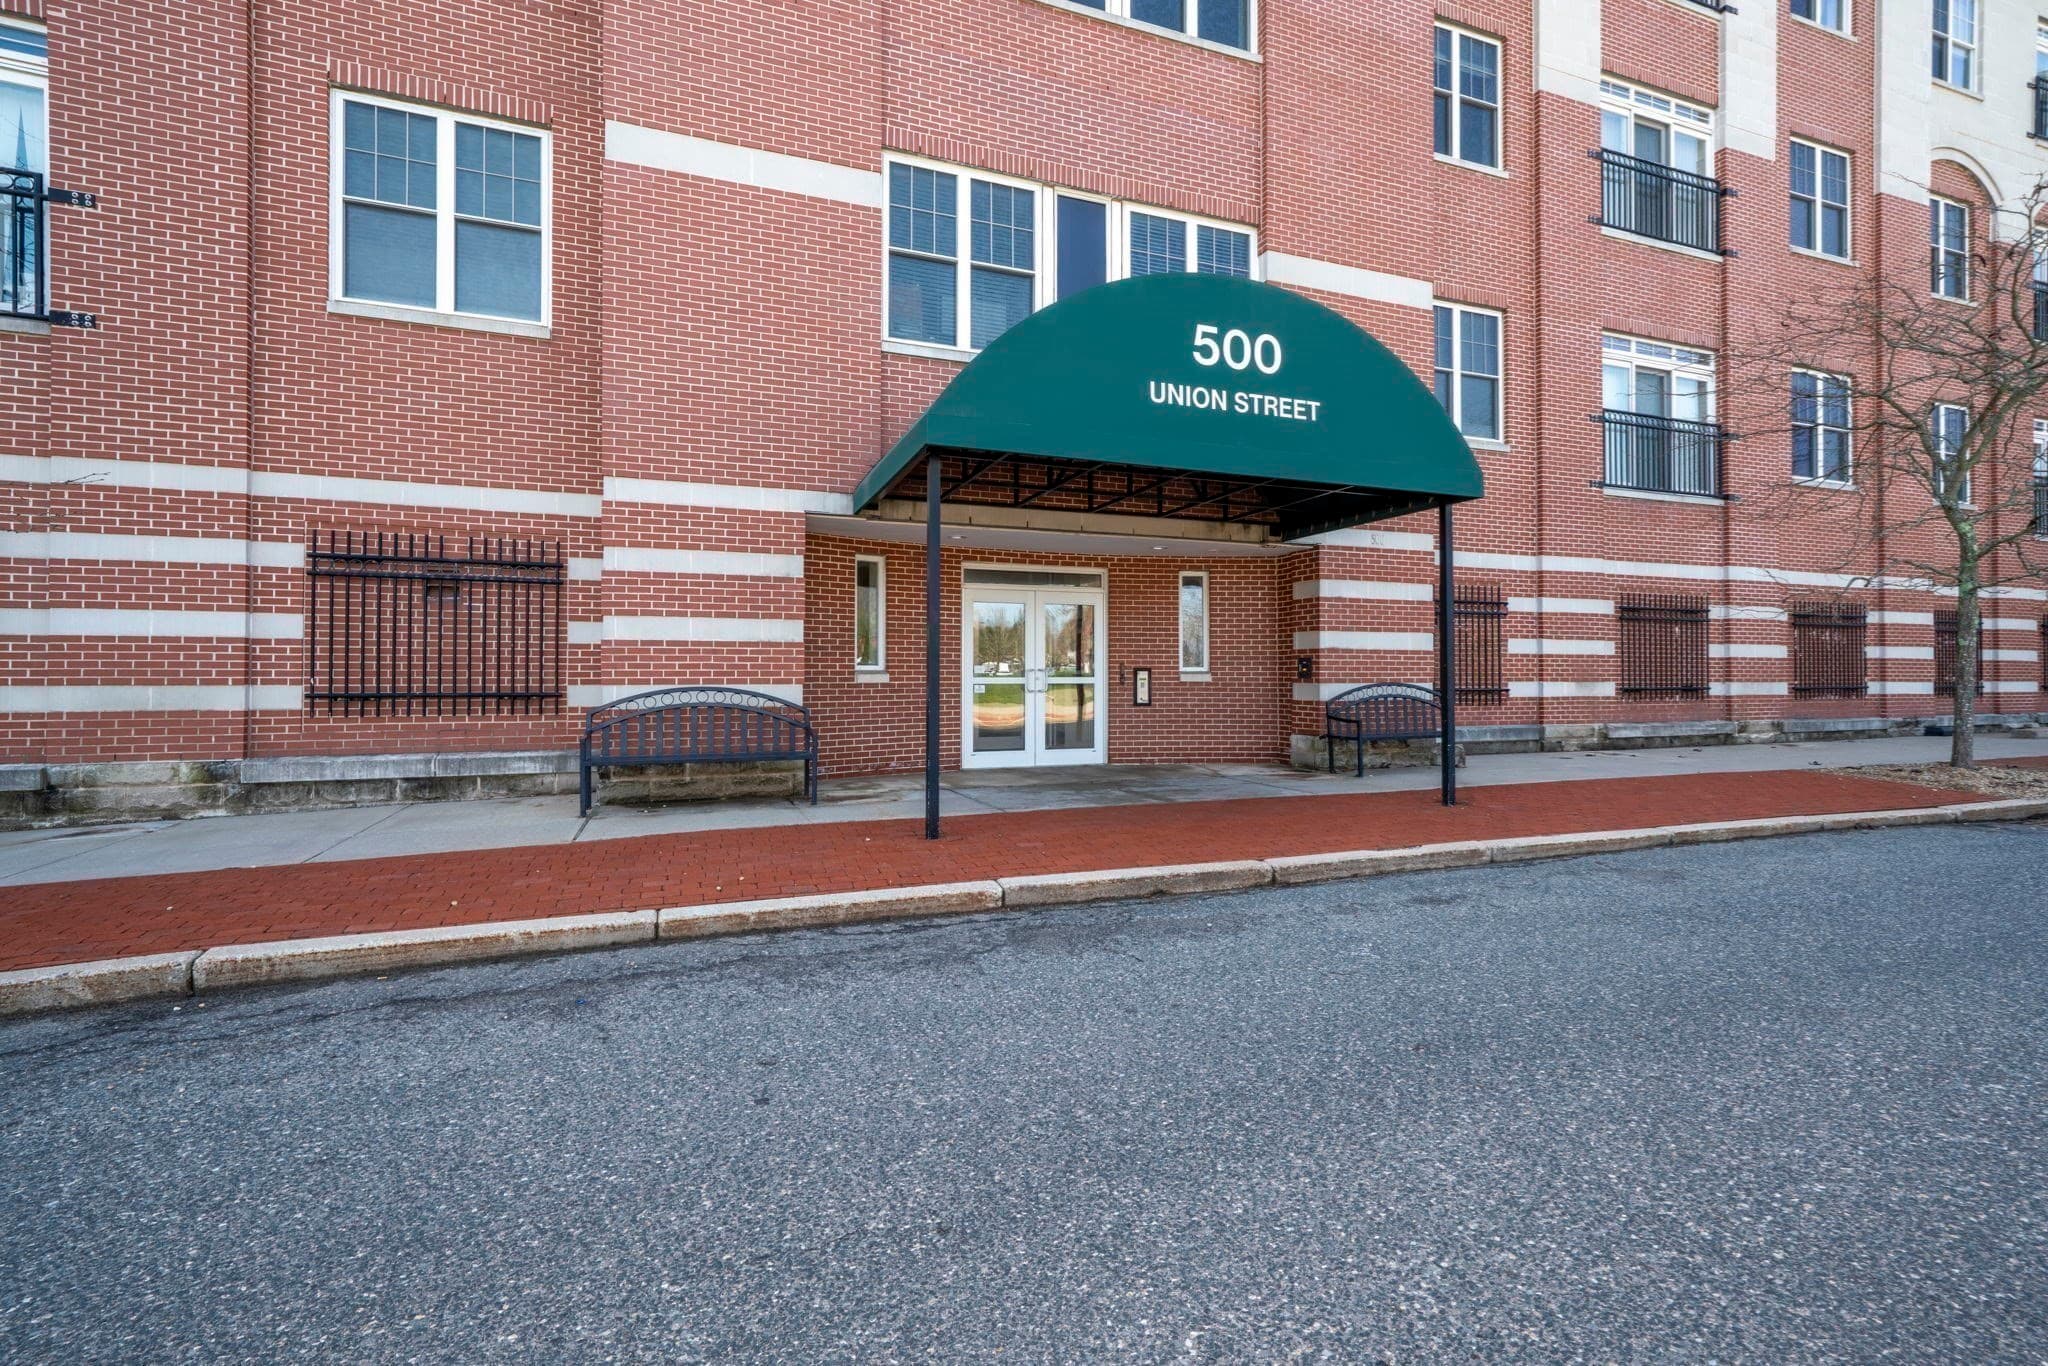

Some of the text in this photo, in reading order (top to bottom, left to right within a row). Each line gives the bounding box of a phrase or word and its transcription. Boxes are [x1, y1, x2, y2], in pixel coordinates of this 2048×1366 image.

[1193, 324, 1282, 374] 500
[1150, 381, 1320, 421] UNION STREET
